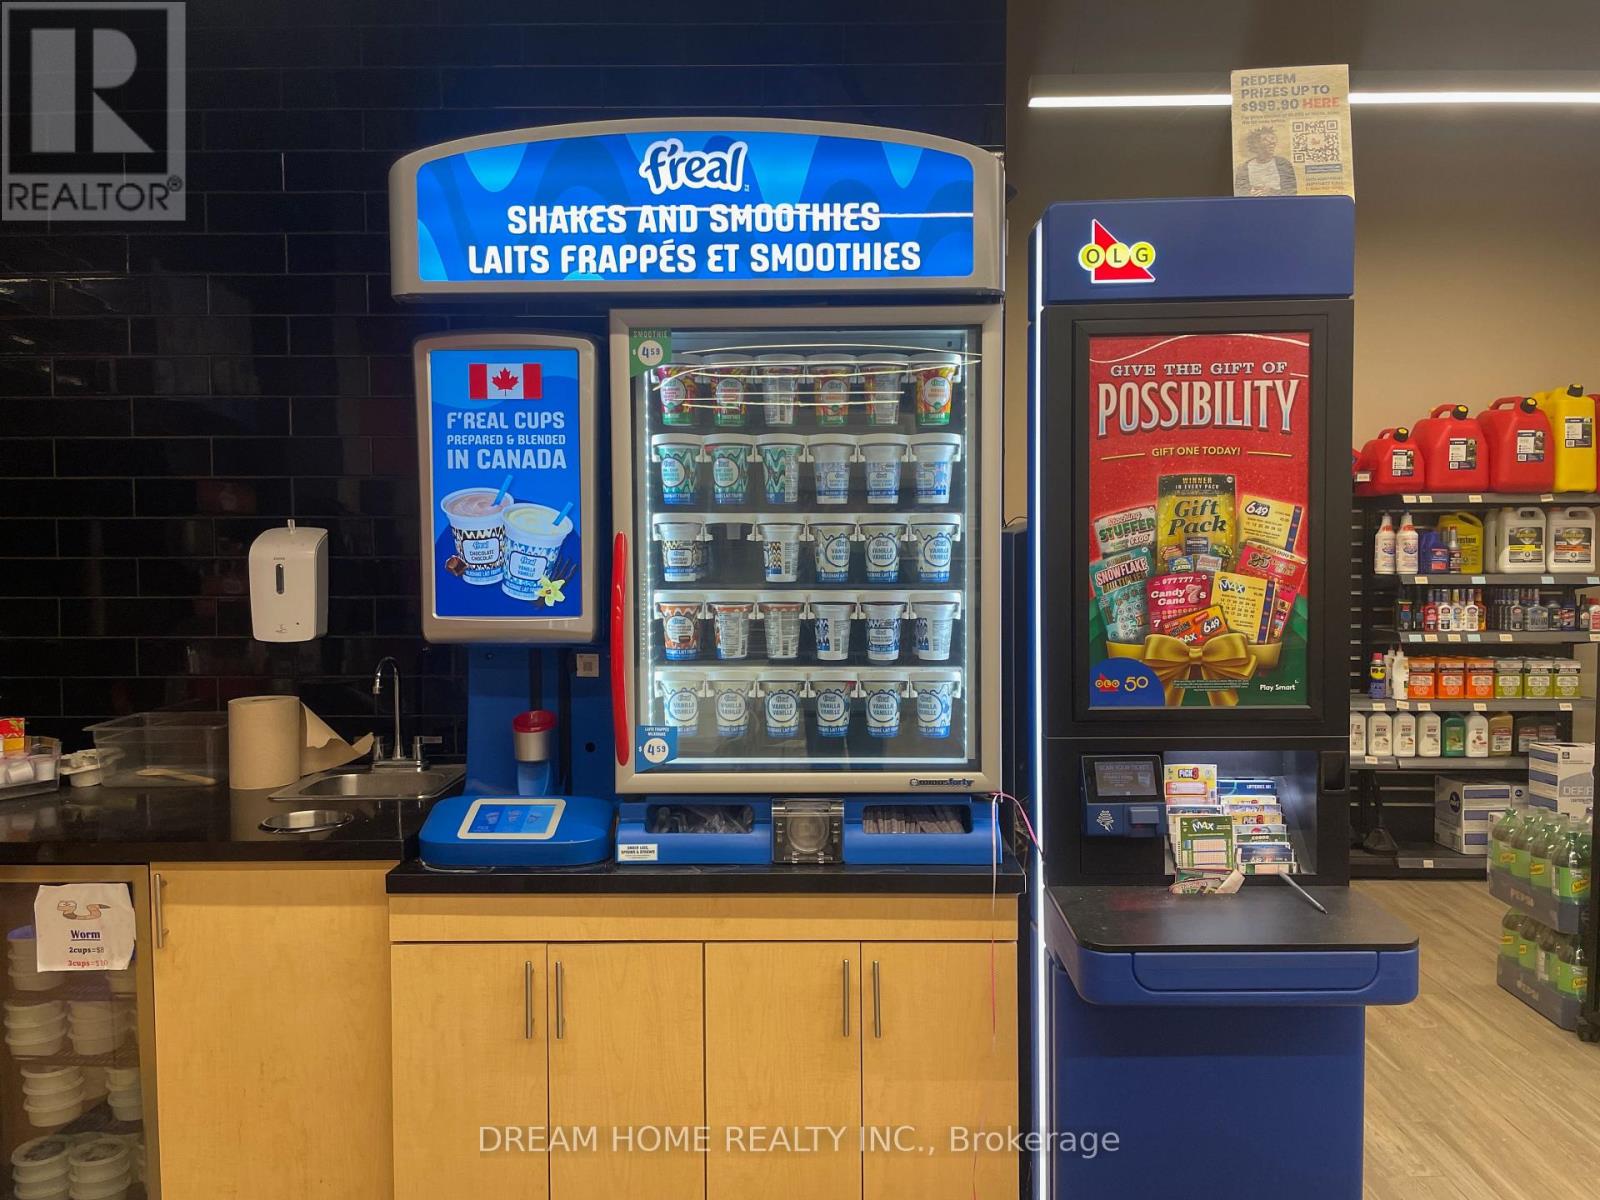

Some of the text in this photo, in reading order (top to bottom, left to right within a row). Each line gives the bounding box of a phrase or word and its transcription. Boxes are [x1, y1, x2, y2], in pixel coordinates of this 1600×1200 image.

[1241, 73, 1296, 87] REDEEM
[1241, 85, 1330, 99] PRIZES UP TO
[1302, 97, 1340, 109] HERE
[507, 203, 881, 235] SHAKES AND SMOOTHIES
[468, 238, 922, 275] LAITS FRAPPÉS ET SMOOTHIES
[1083, 245, 1152, 266] OLG
[1110, 361, 1287, 377] GIVE THE GIFT OF
[1097, 379, 1299, 439] POSSIBILITY
[447, 411, 565, 430] F'REAL CUPS
[447, 434, 566, 446] PREPARED & BLENDED
[447, 449, 567, 470] IN CANADA
[1151, 446, 1241, 457] GIFT ONE TODAY!
[1174, 498, 1220, 518] Gift
[1098, 518, 1156, 542] STUFFER
[1168, 515, 1227, 536] Pack
[1096, 556, 1148, 586] SNOWFLAKE
[1150, 588, 1186, 599] Candy
[1158, 597, 1185, 606] Cane
[1124, 675, 1149, 692] 50
[1259, 683, 1274, 692] Play
[1275, 683, 1296, 691] Smart
[1191, 820, 1215, 832] MAX
[70, 929, 101, 939] Worm
